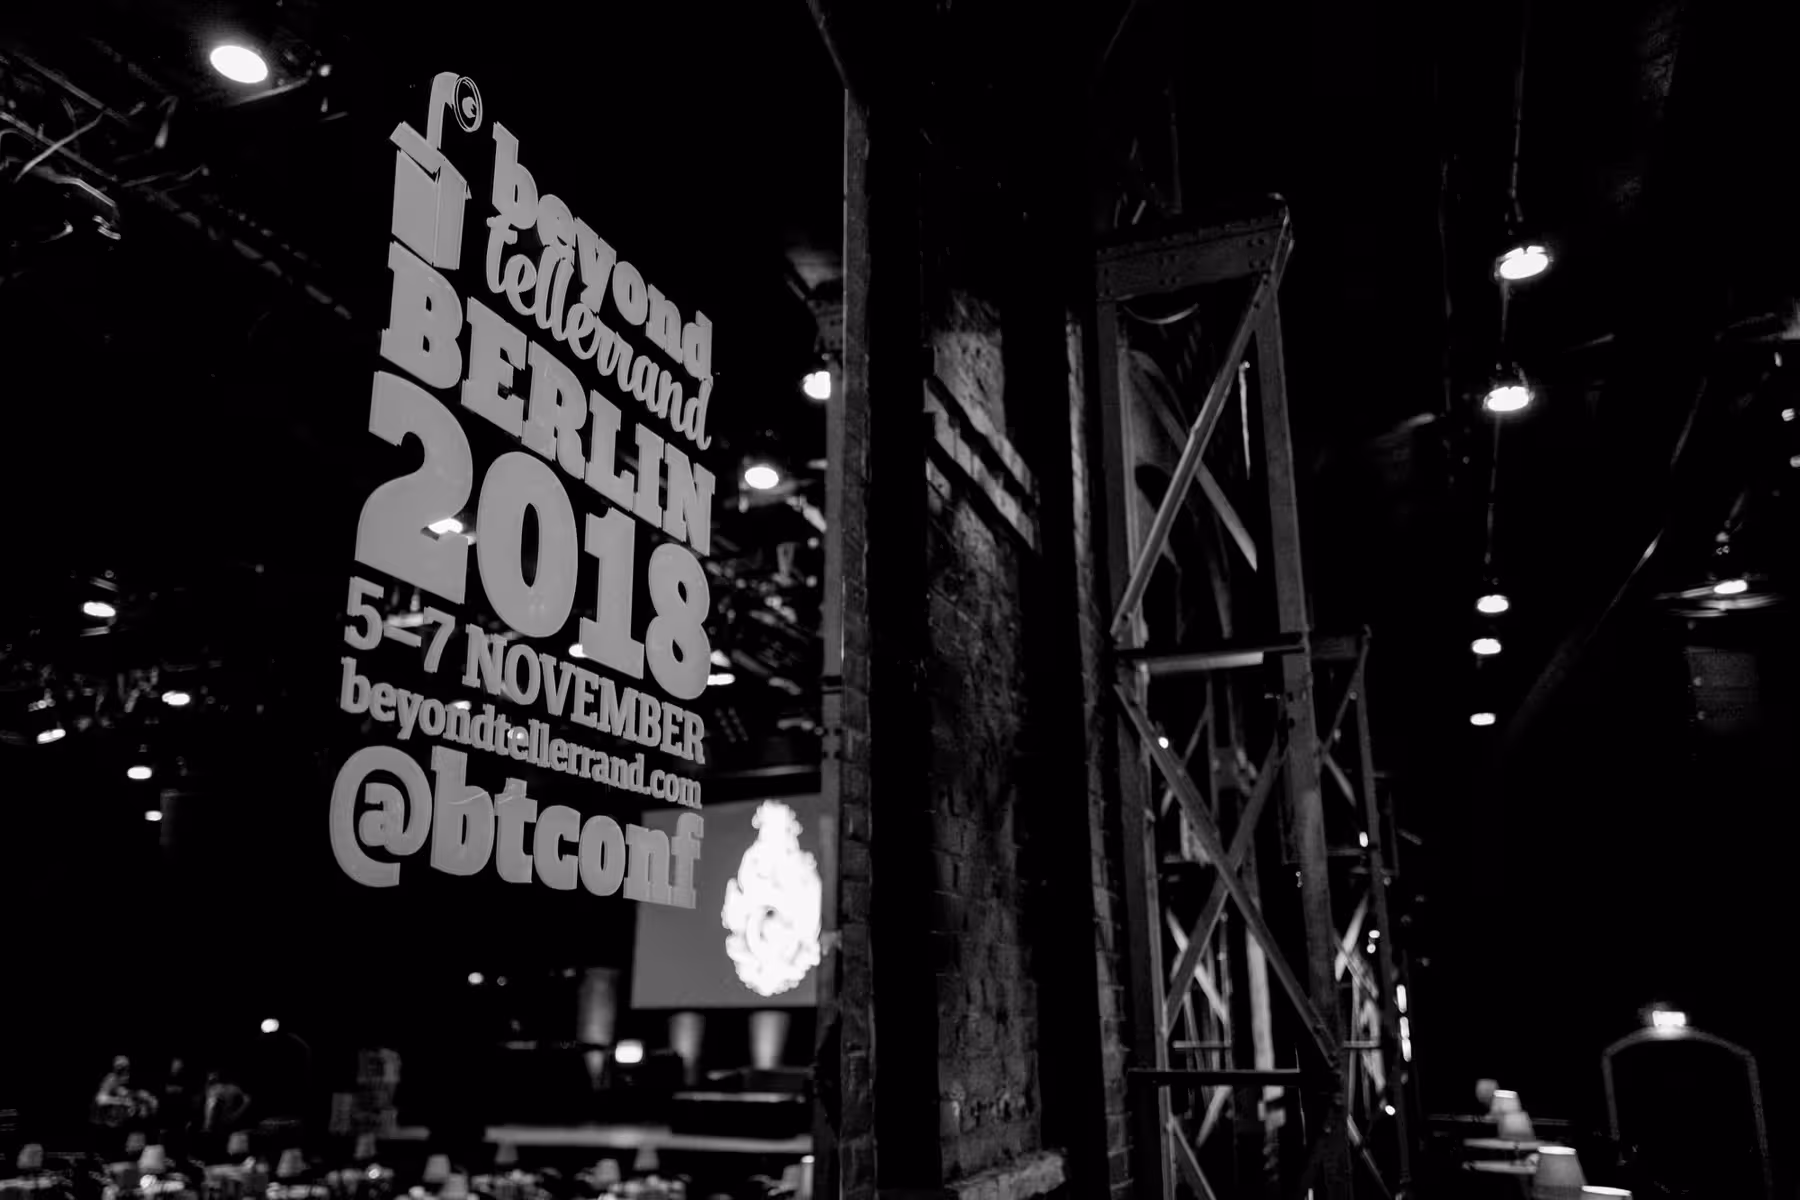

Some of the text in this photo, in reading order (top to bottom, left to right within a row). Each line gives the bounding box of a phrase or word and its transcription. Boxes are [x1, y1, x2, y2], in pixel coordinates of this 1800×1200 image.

[485, 213, 714, 451] tellerrand
[492, 120, 714, 380] beyond
[379, 240, 716, 557] BERLIN
[354, 370, 711, 700] 2018
[340, 656, 703, 810] beyondtellerrand.com
[462, 623, 706, 764] NOVEMBER
[329, 744, 705, 910] @btconf
